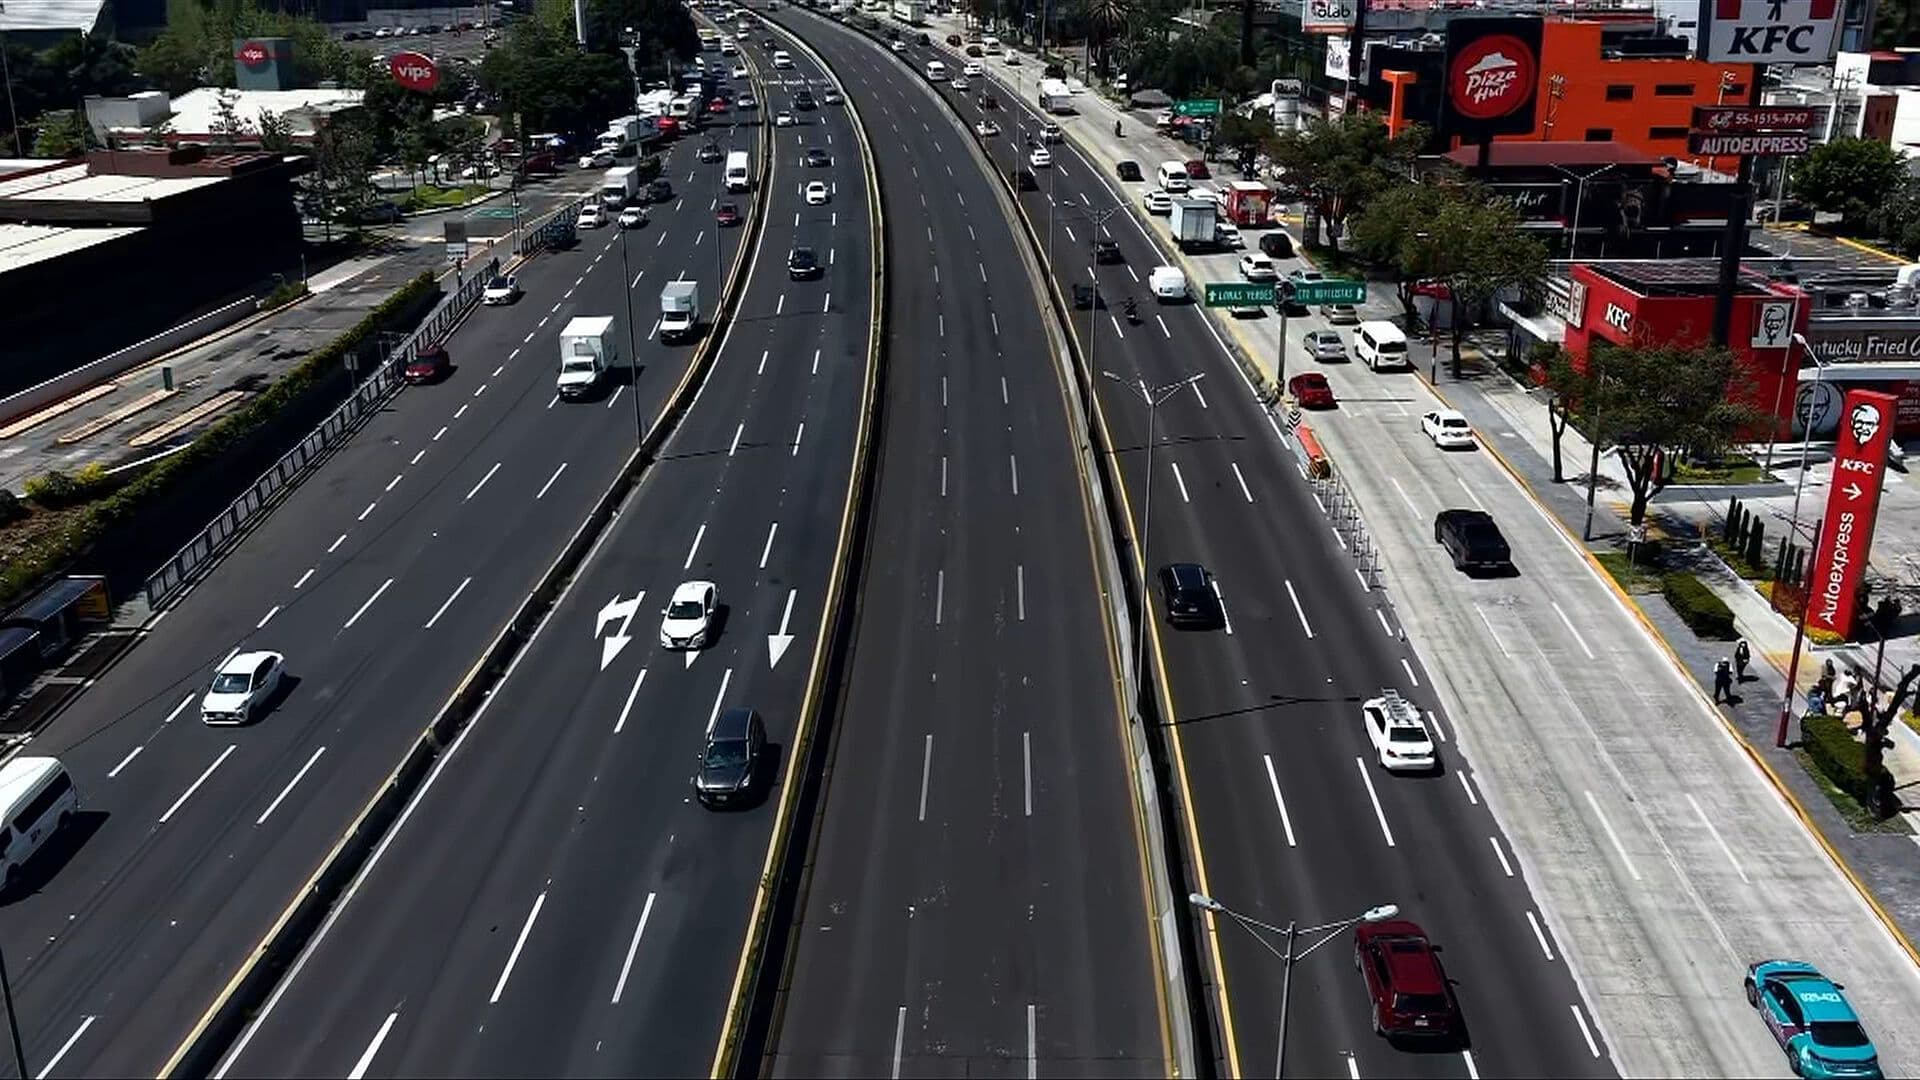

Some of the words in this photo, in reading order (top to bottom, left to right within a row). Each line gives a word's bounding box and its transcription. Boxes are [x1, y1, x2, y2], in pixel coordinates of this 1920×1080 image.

[1727, 25, 1815, 55] KFC
[244, 48, 263, 60] vips
[397, 63, 432, 82] vips
[1465, 71, 1517, 96] Pizza
[1473, 82, 1511, 104] Hut
[1700, 136, 1808, 154] AUTOEXPRESS
[1605, 302, 1632, 333] KFC
[1812, 339, 1862, 361] ntucky
[1866, 336, 1907, 357] Fried
[1840, 458, 1875, 475] KFC
[1818, 511, 1856, 625] Autoexpress
